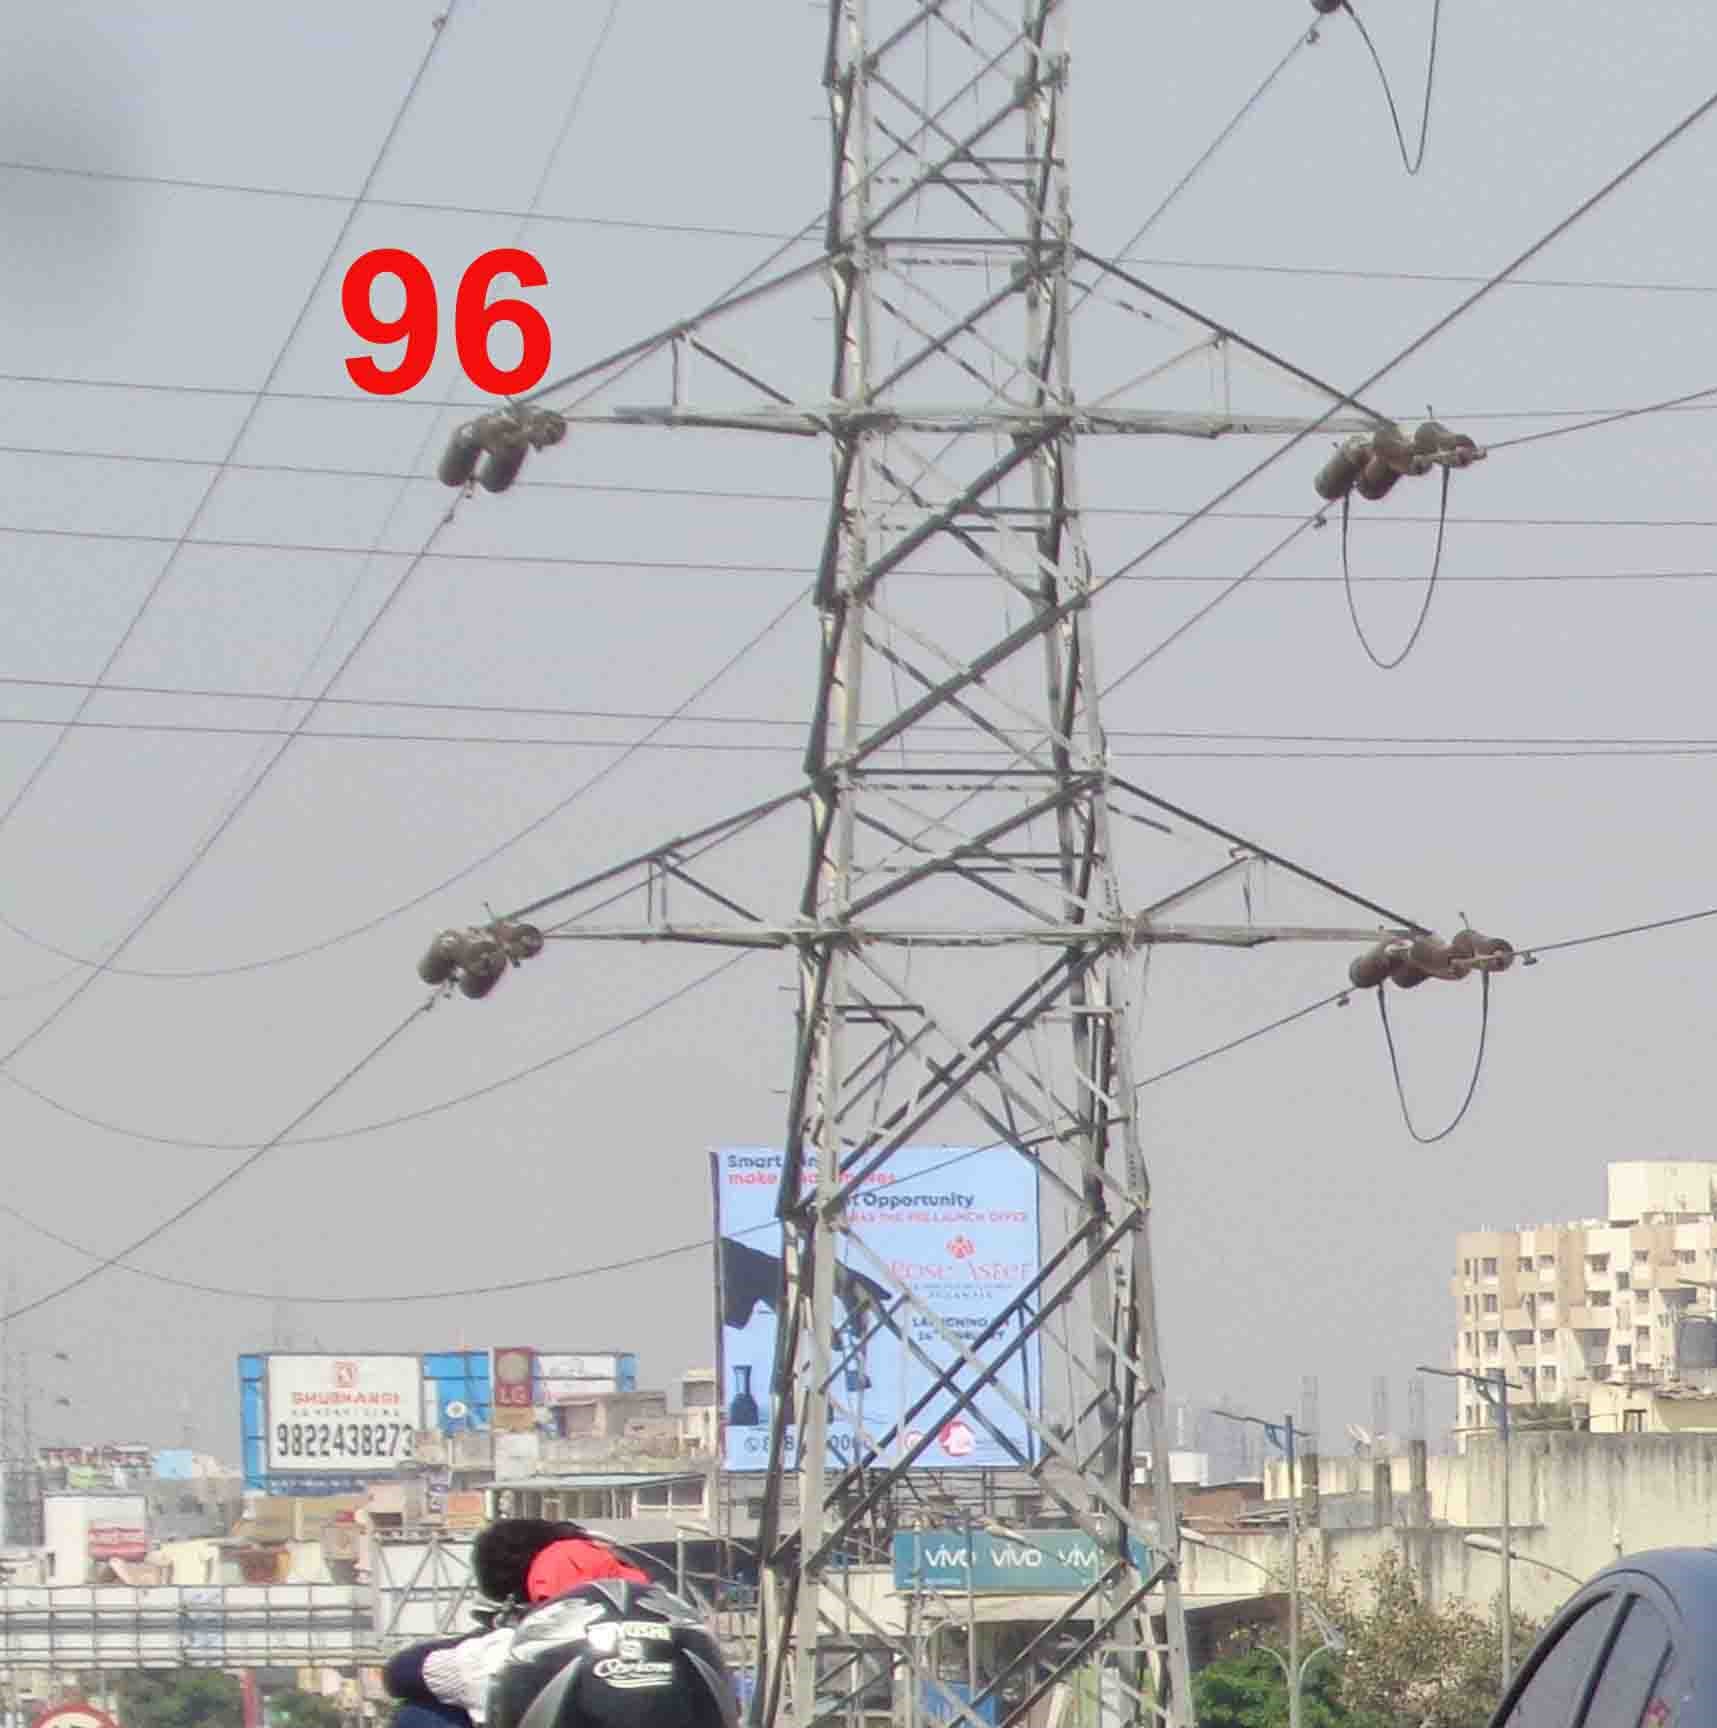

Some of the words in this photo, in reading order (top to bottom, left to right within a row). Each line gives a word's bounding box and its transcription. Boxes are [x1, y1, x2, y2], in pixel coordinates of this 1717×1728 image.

[863, 1193, 976, 1209] Opportunity
[277, 1424, 415, 1457] 9822438273
[991, 1544, 1042, 1568] vivo
